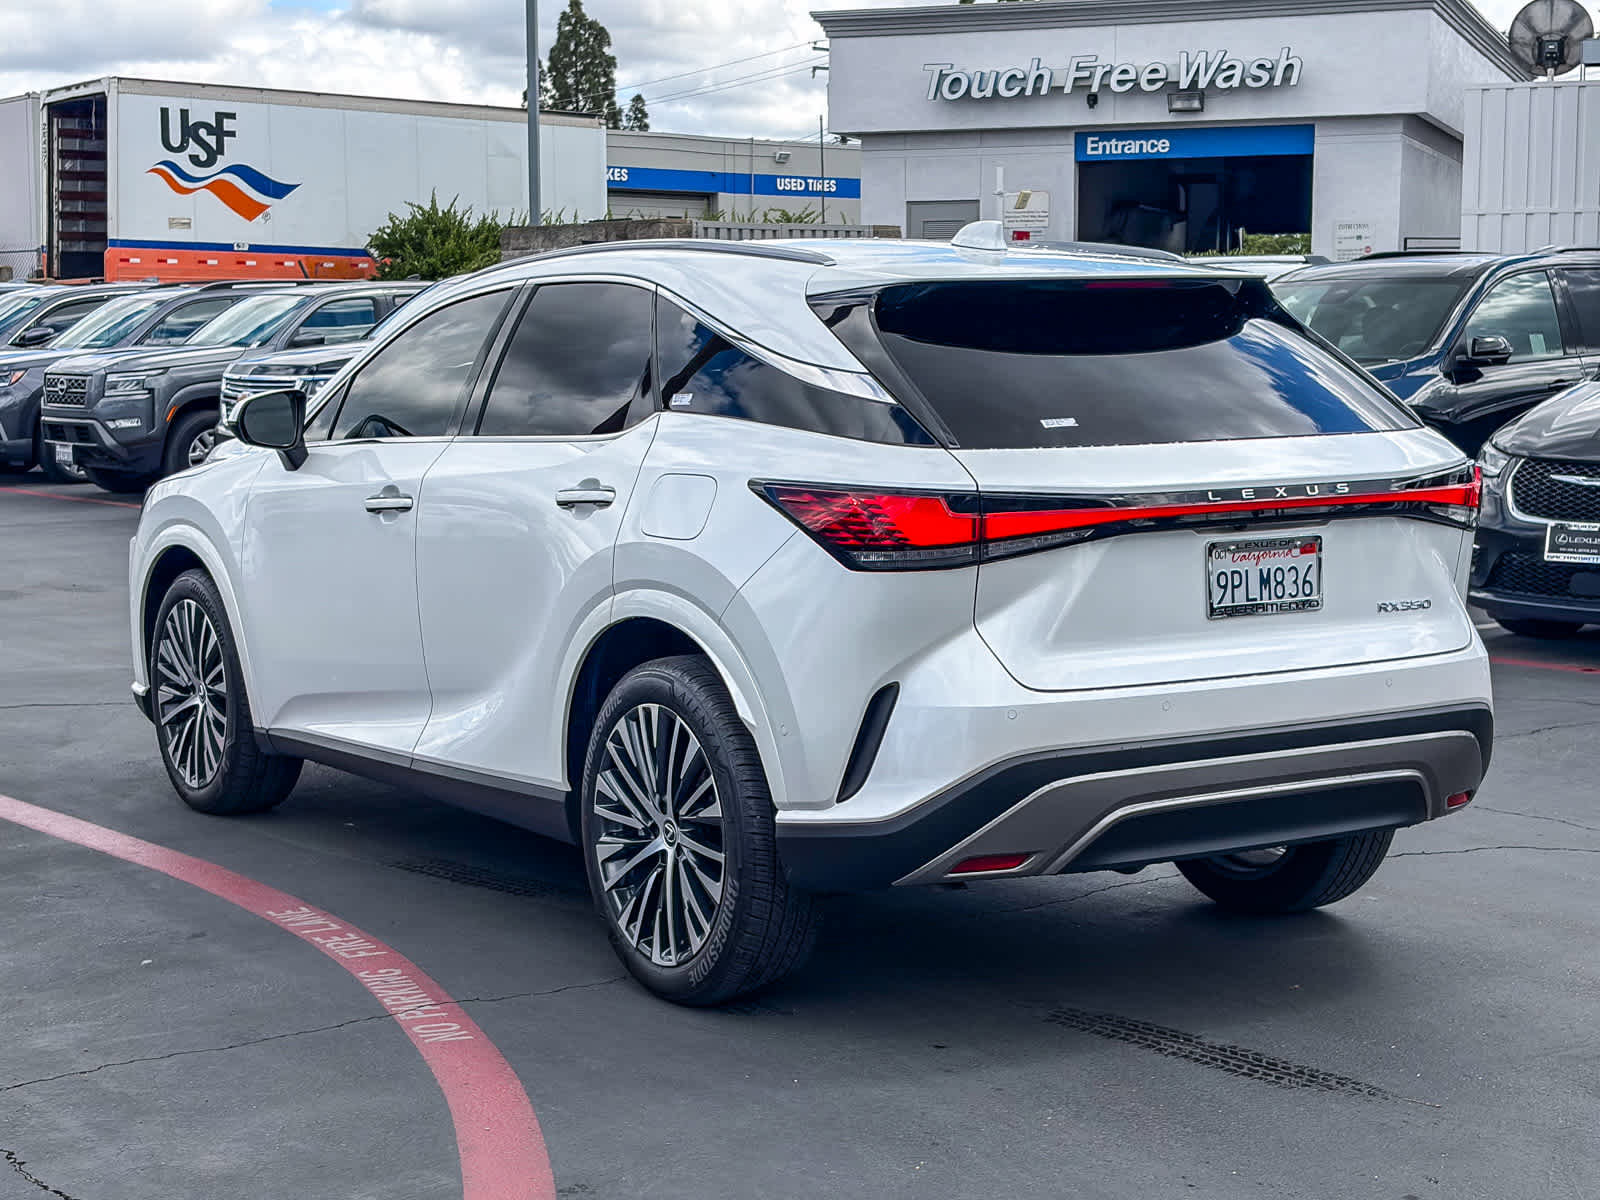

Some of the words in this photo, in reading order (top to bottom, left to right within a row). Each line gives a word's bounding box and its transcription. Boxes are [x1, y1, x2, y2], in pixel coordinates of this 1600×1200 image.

[922, 57, 1052, 101] Touch
[1063, 54, 1168, 94] Free
[1178, 46, 1304, 90] Wash
[159, 106, 237, 168] USF
[1086, 136, 1170, 156] Entrance
[776, 177, 805, 191] USED
[807, 179, 837, 192] TIRES
[1207, 483, 1351, 501] LEXUS
[1568, 536, 1600, 545] LEXU
[1231, 549, 1298, 566] California
[1216, 562, 1314, 605] 9PLM836
[266, 906, 342, 934] LANE
[312, 933, 387, 959] FIRE
[359, 968, 448, 1020] PARKING
[412, 1022, 474, 1043] NO
